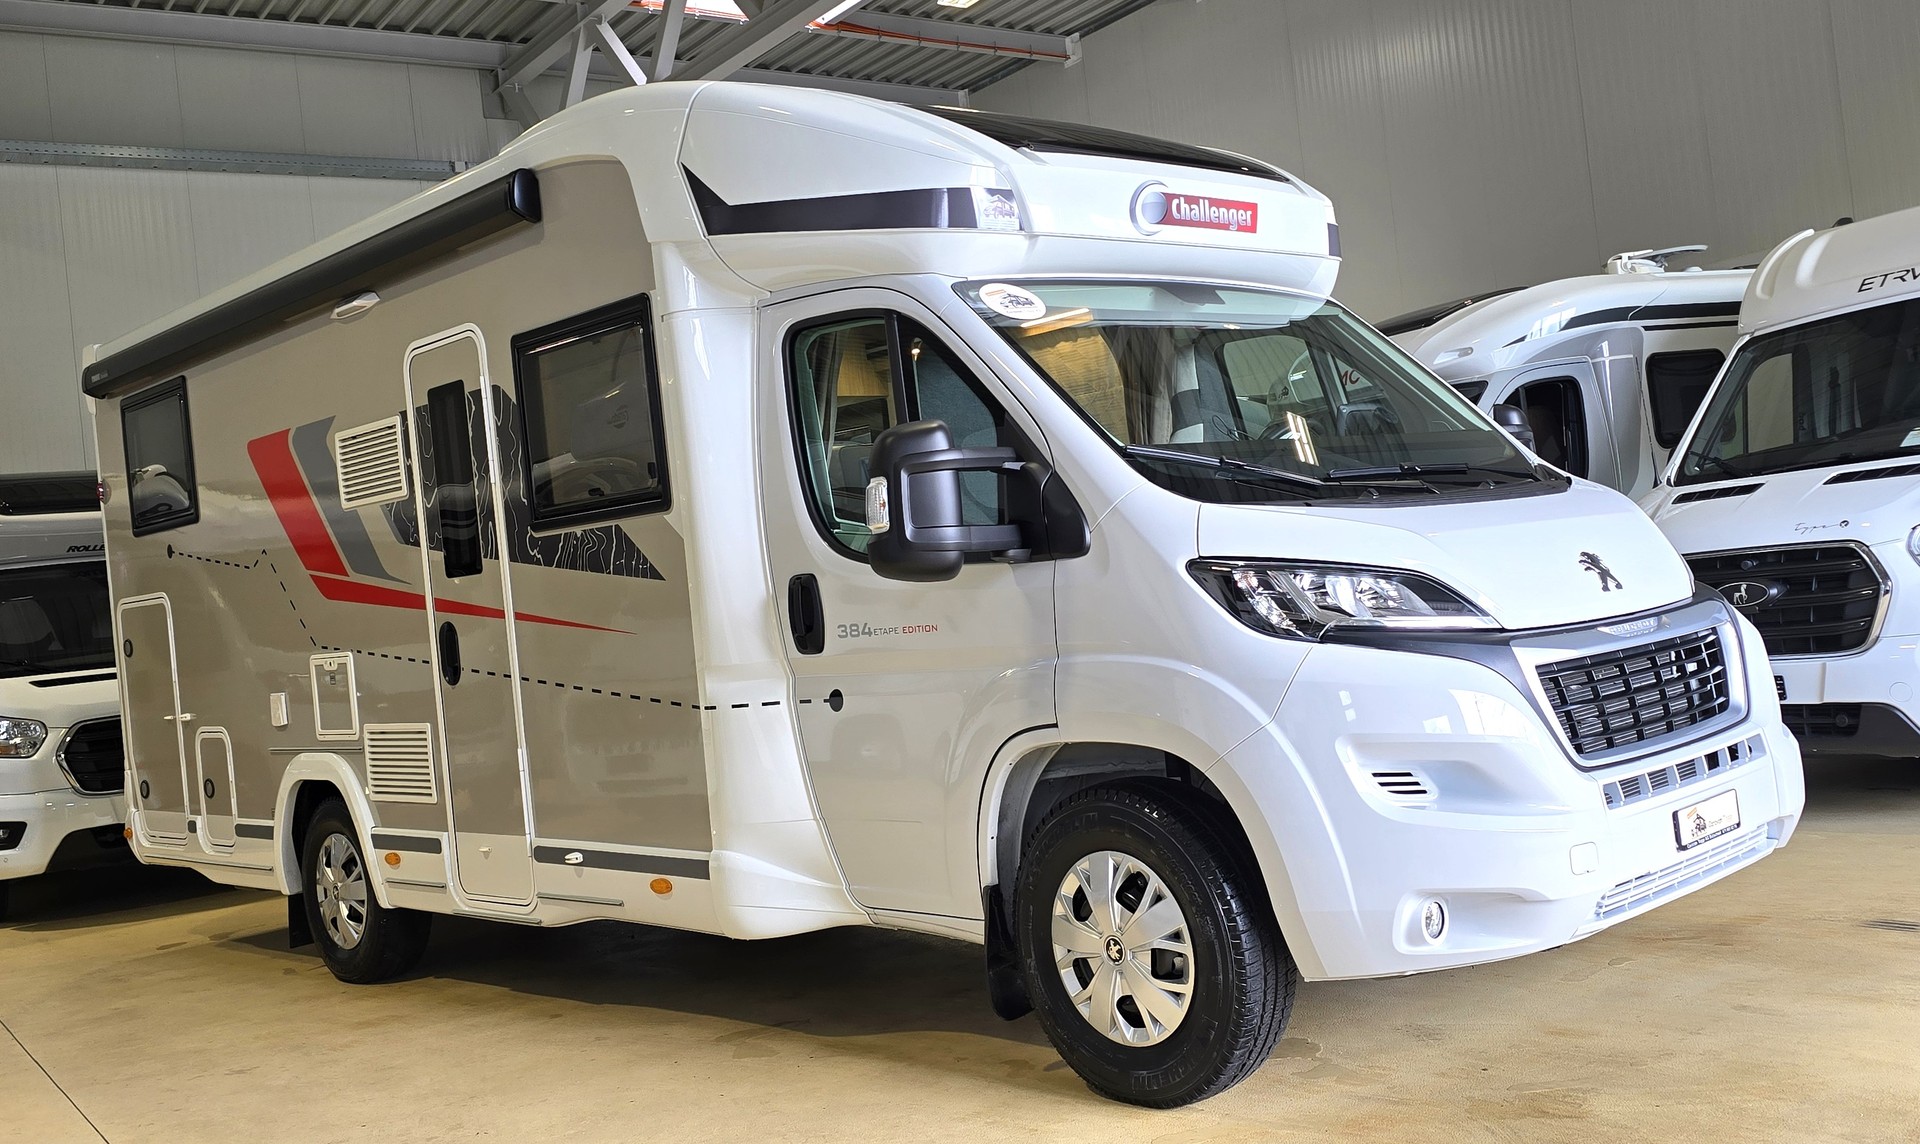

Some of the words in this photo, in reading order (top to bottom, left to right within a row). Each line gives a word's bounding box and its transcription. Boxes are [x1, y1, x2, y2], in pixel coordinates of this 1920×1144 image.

[1171, 197, 1253, 231] Challenger
[837, 622, 873, 639] 384
[873, 627, 900, 636] ETAPE
[902, 624, 938, 634] EDITION
